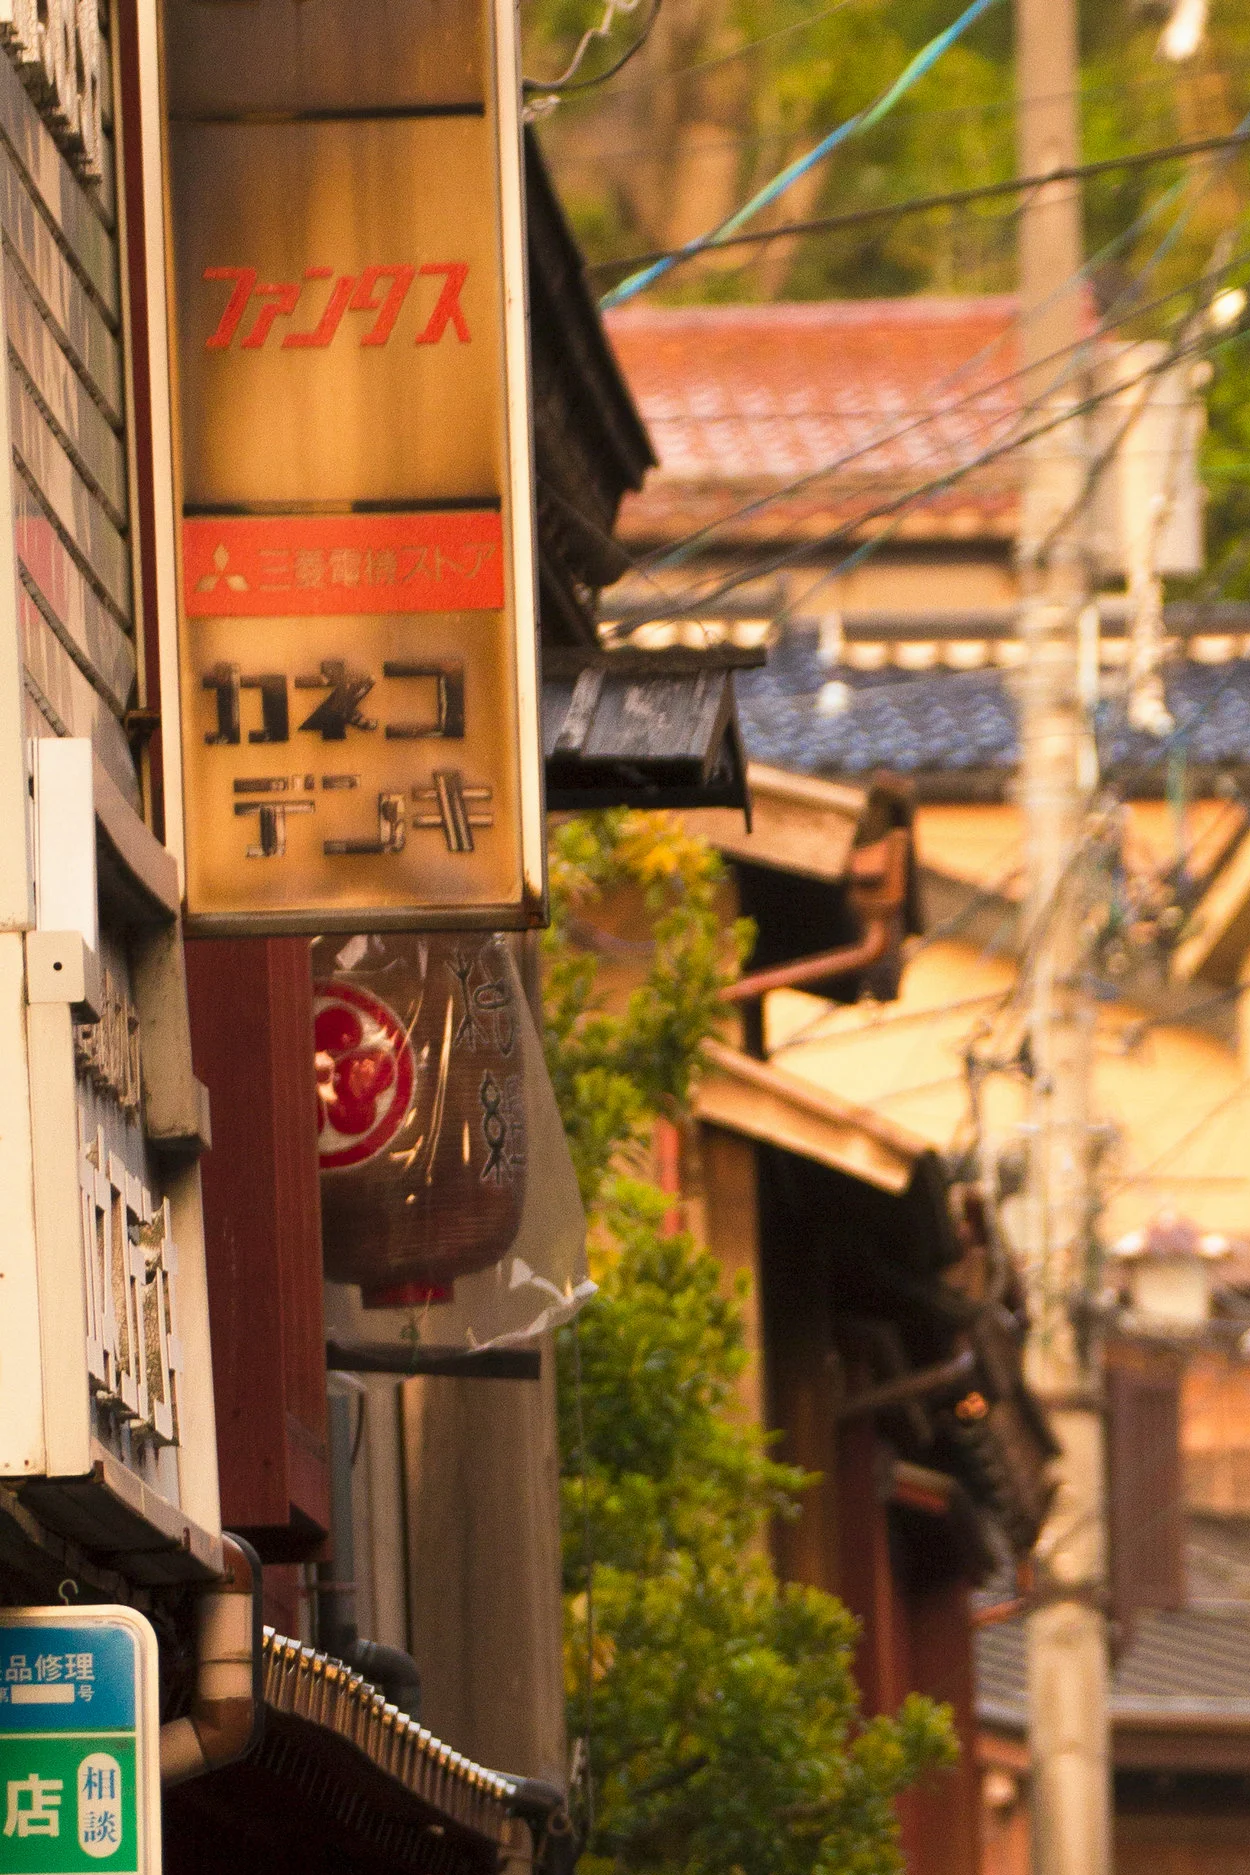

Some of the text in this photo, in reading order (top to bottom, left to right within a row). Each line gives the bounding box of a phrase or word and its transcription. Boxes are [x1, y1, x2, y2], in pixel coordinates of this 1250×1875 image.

[202, 659, 466, 745] カネコ
[233, 769, 493, 858] デンキ
[0, 1653, 95, 1682] 品修理
[3, 1773, 64, 1837] 店
[82, 1766, 118, 1843] 相談
